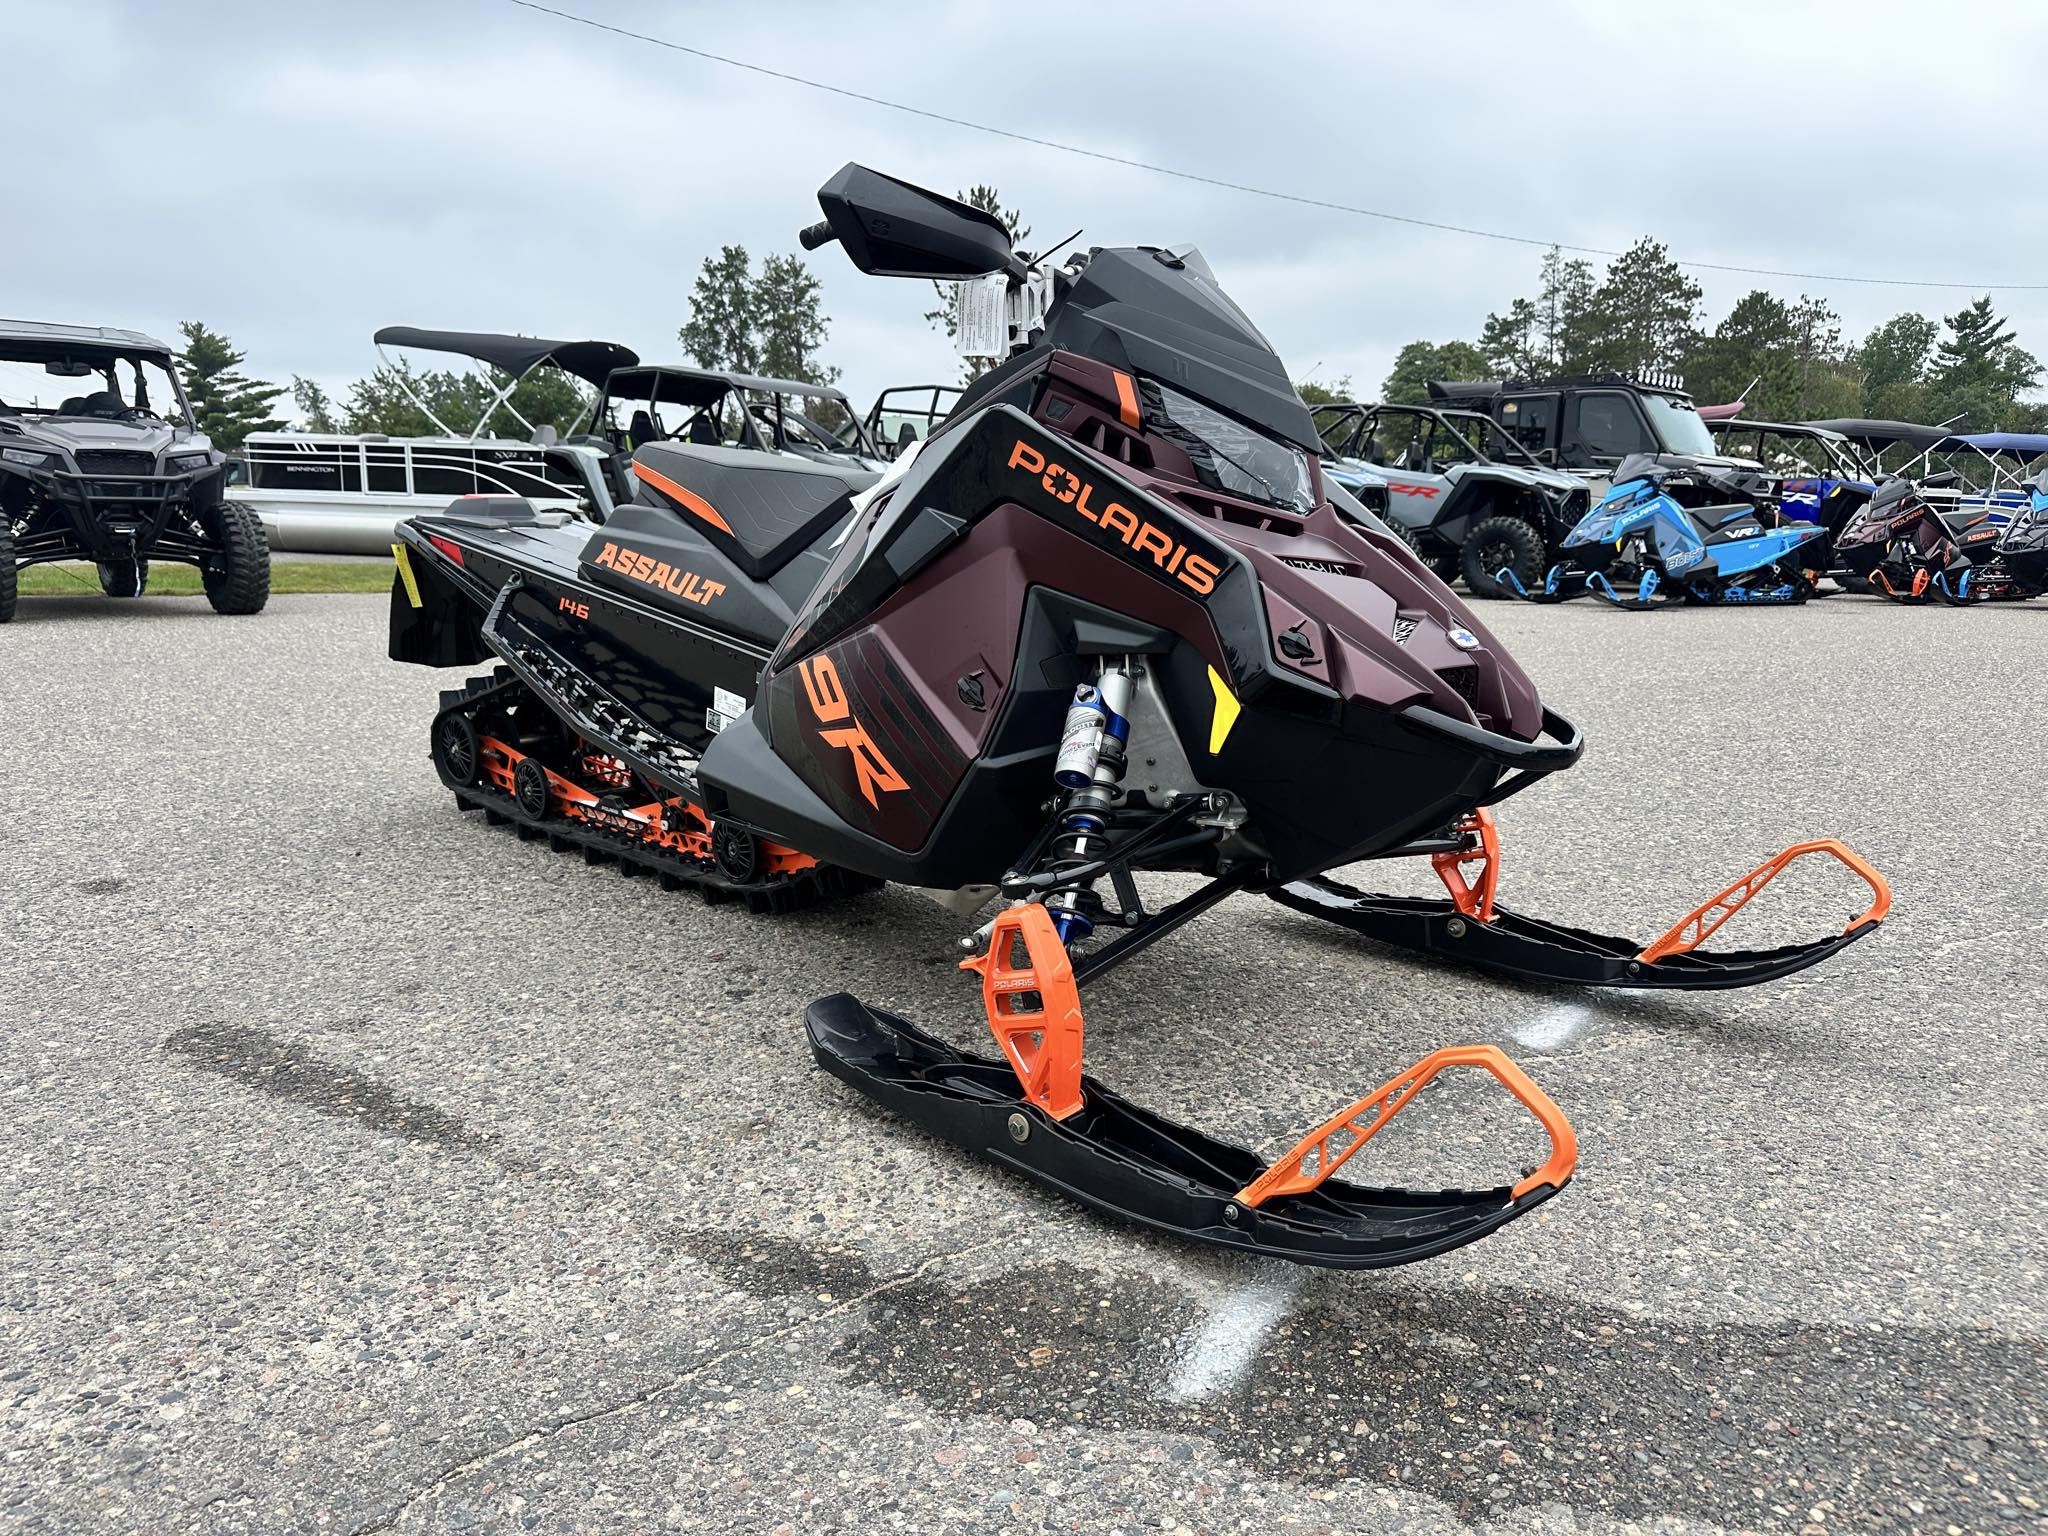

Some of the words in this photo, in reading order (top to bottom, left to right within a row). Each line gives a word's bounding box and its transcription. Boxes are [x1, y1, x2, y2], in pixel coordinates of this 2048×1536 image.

[1008, 440, 1221, 594] POLARIS
[1622, 503, 1661, 524] POLARIS
[1891, 509, 1925, 528] POLARIS
[1725, 526, 1760, 539] VR1
[1967, 530, 1998, 542] ASSAULT
[595, 543, 727, 605] ASSAULT
[559, 598, 590, 620] 146
[798, 654, 911, 811] 9R
[993, 978, 1035, 989] POLARIS
[1254, 1150, 1300, 1190] POLARIS
